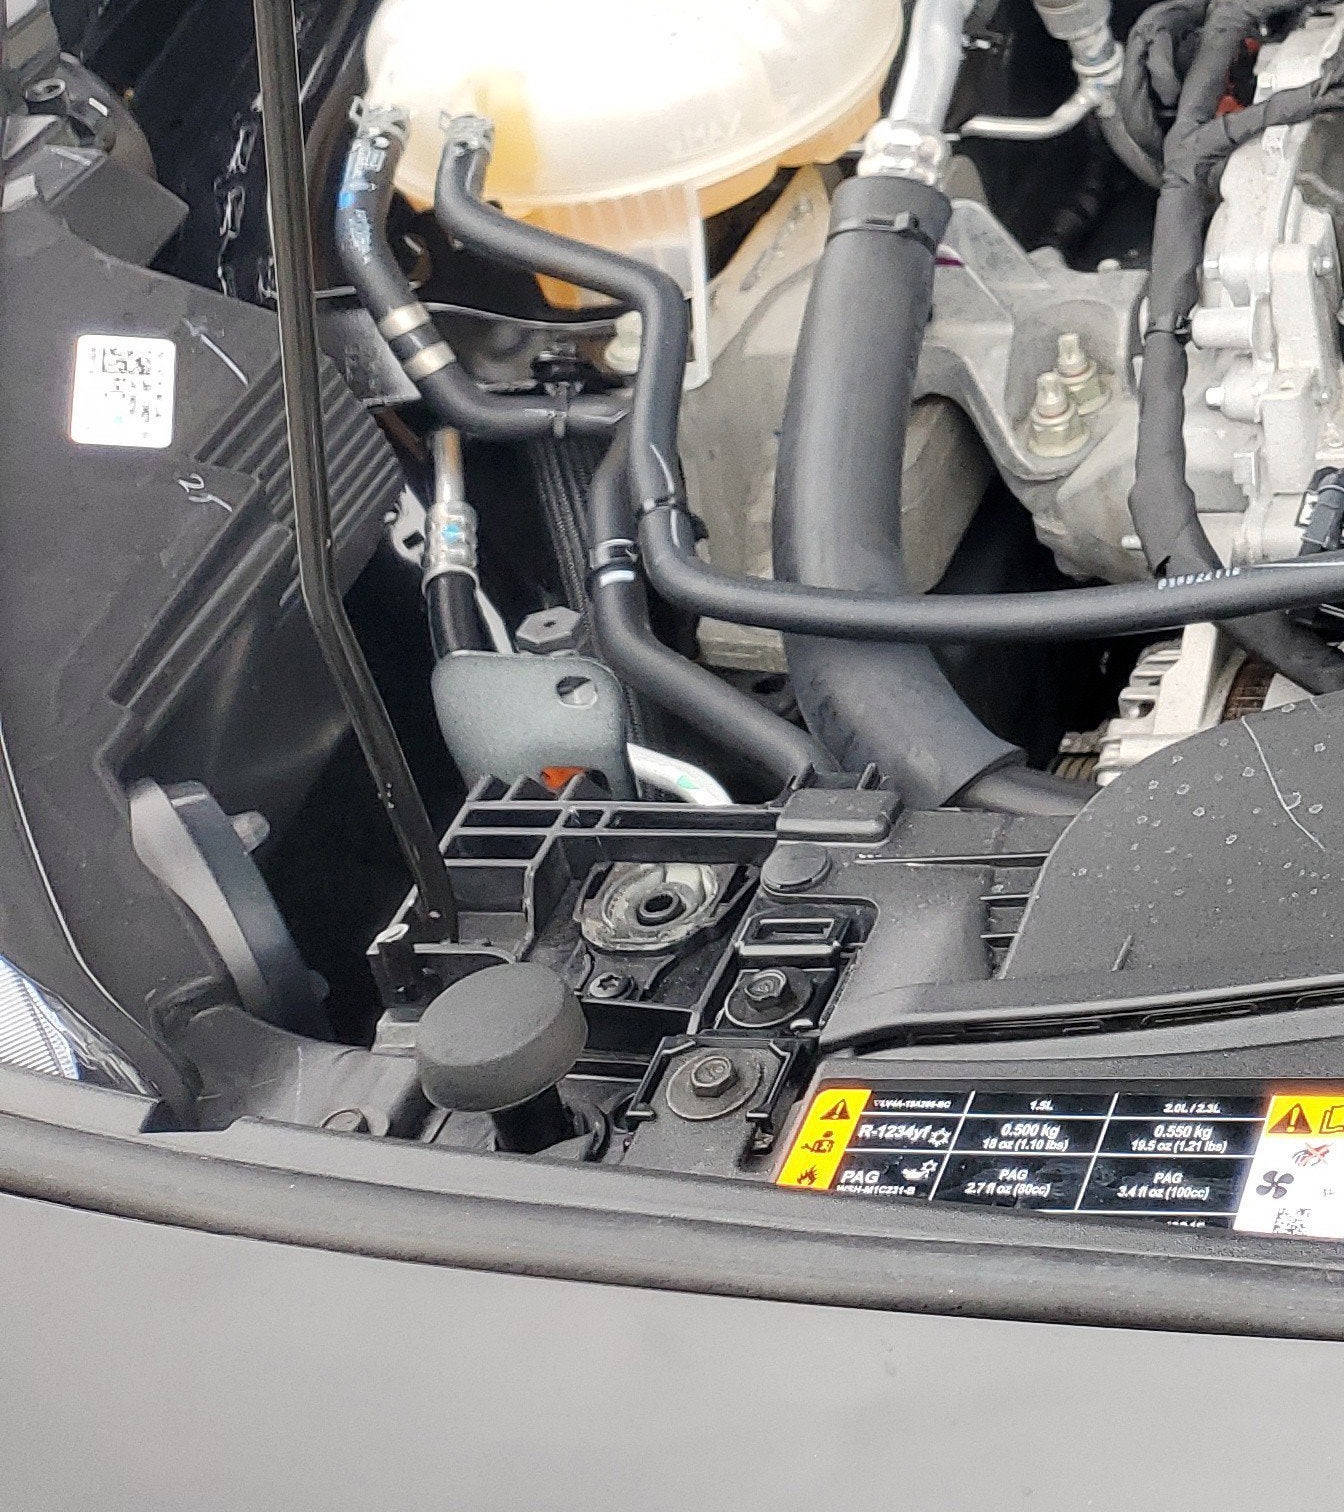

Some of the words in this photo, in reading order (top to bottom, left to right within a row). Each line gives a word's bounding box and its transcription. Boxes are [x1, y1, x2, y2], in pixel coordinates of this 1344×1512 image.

[858, 1124, 932, 1144] R-1234yf
[1001, 1122, 1040, 1137] 0.500
[1041, 1122, 1061, 1140] kg
[1154, 1124, 1193, 1138] 0.550
[1193, 1124, 1213, 1141] kg
[983, 1137, 998, 1149] 18
[999, 1140, 1014, 1150] oz
[1014, 1138, 1045, 1152] (1.10
[1045, 1138, 1070, 1152] lbs)
[1131, 1139, 1157, 1152] 19.5
[1157, 1142, 1173, 1152] oz
[1173, 1140, 1202, 1154] (1.21
[1204, 1140, 1228, 1154] lbs)
[840, 1169, 880, 1184] PAG
[999, 1168, 1029, 1181] PAG
[1153, 1172, 1183, 1184] PAG
[965, 1182, 986, 1194] 2.7
[996, 1184, 1012, 1195] oz
[1012, 1182, 1051, 1198] (80cc)
[1117, 1185, 1137, 1198] 3.4
[1148, 1188, 1165, 1198] oz
[1165, 1186, 1210, 1201] (100cc)
